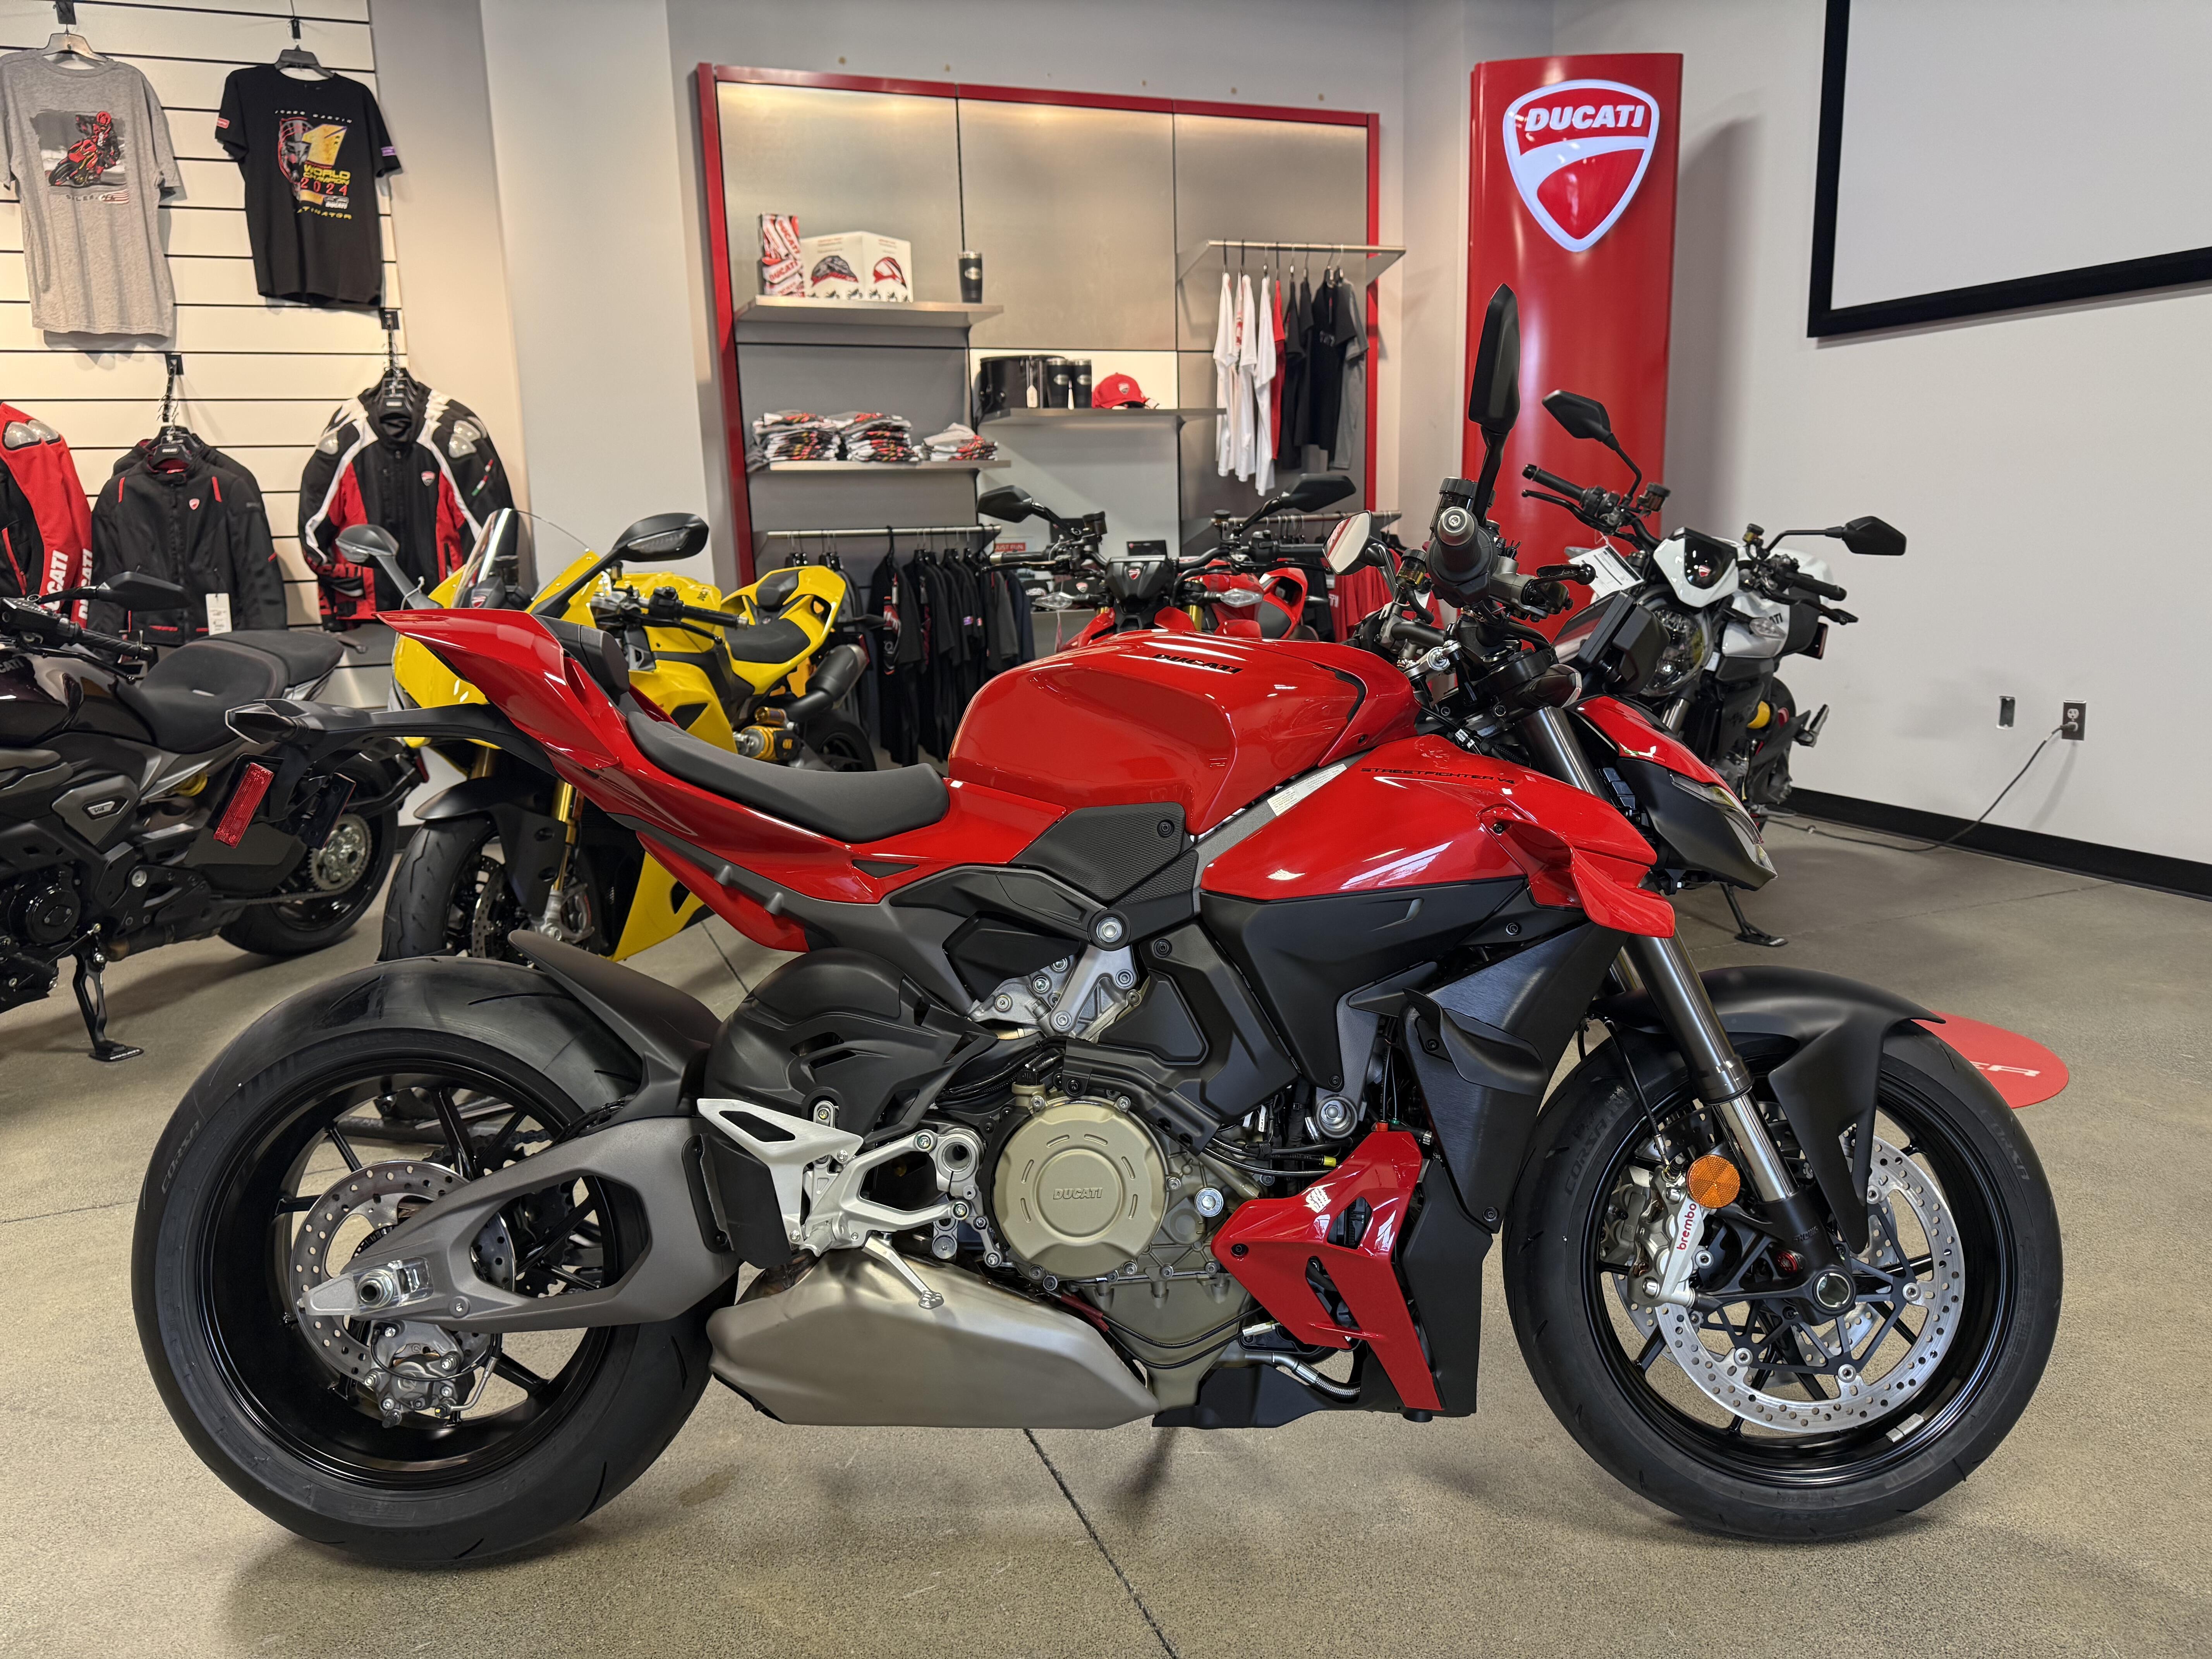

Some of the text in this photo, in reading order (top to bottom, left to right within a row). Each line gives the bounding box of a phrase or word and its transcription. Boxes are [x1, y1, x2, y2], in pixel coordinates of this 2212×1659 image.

[1525, 105, 1645, 132] DUCATI
[304, 164, 350, 180] WORLD
[300, 177, 348, 196] 2024
[769, 260, 798, 281] DUCATI
[1152, 654, 1244, 674] DUCATI
[1360, 768, 1494, 781] STREETFIGHTER
[1979, 1109, 2030, 1180] CORSA
[161, 1119, 200, 1194] CORSA
[1565, 1118, 1607, 1195] CORSA
[1053, 1187, 1103, 1200] DUCATI
[1676, 1203, 1697, 1250] brembo
